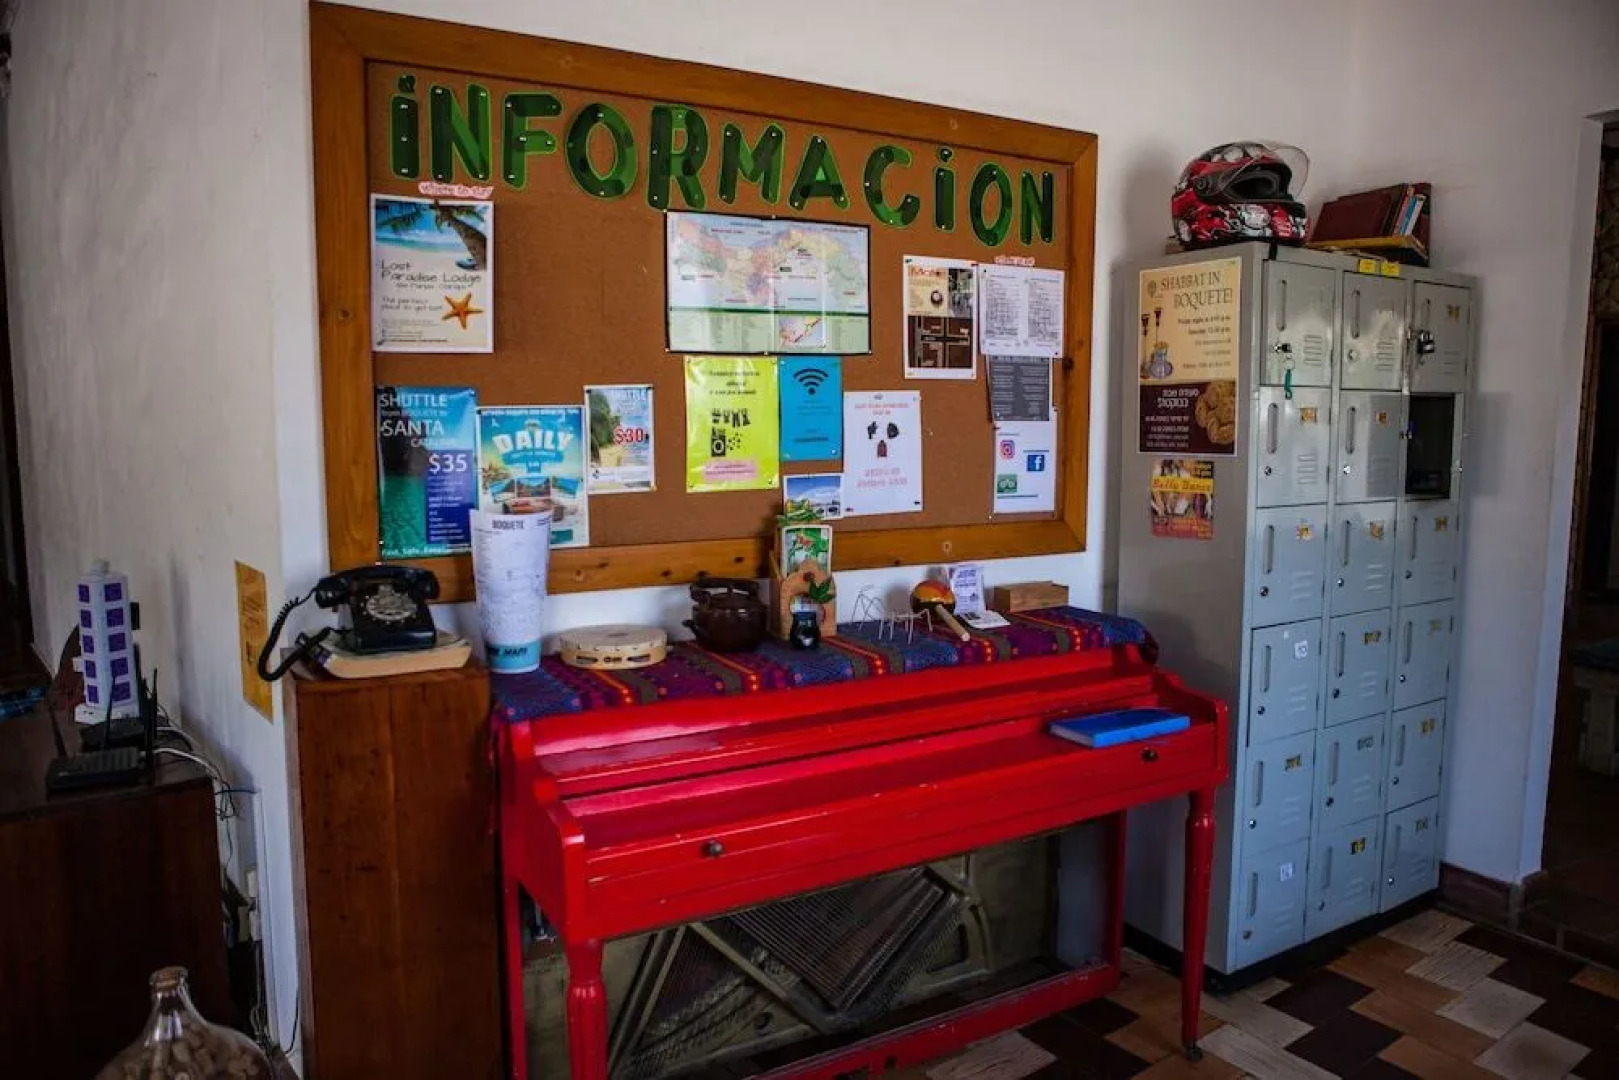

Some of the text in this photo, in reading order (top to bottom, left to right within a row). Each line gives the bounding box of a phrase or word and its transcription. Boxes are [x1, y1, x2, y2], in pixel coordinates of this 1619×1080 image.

[381, 259, 412, 271] Lost
[381, 269, 438, 282] Paradise
[443, 271, 482, 288] Lodge
[1161, 271, 1220, 291] SHABBAT IN
[381, 392, 448, 408] SHUTTLE
[382, 419, 445, 438] SANTA
[614, 427, 644, 445] $30
[492, 429, 573, 454] DAILY
[428, 453, 468, 475] $35
